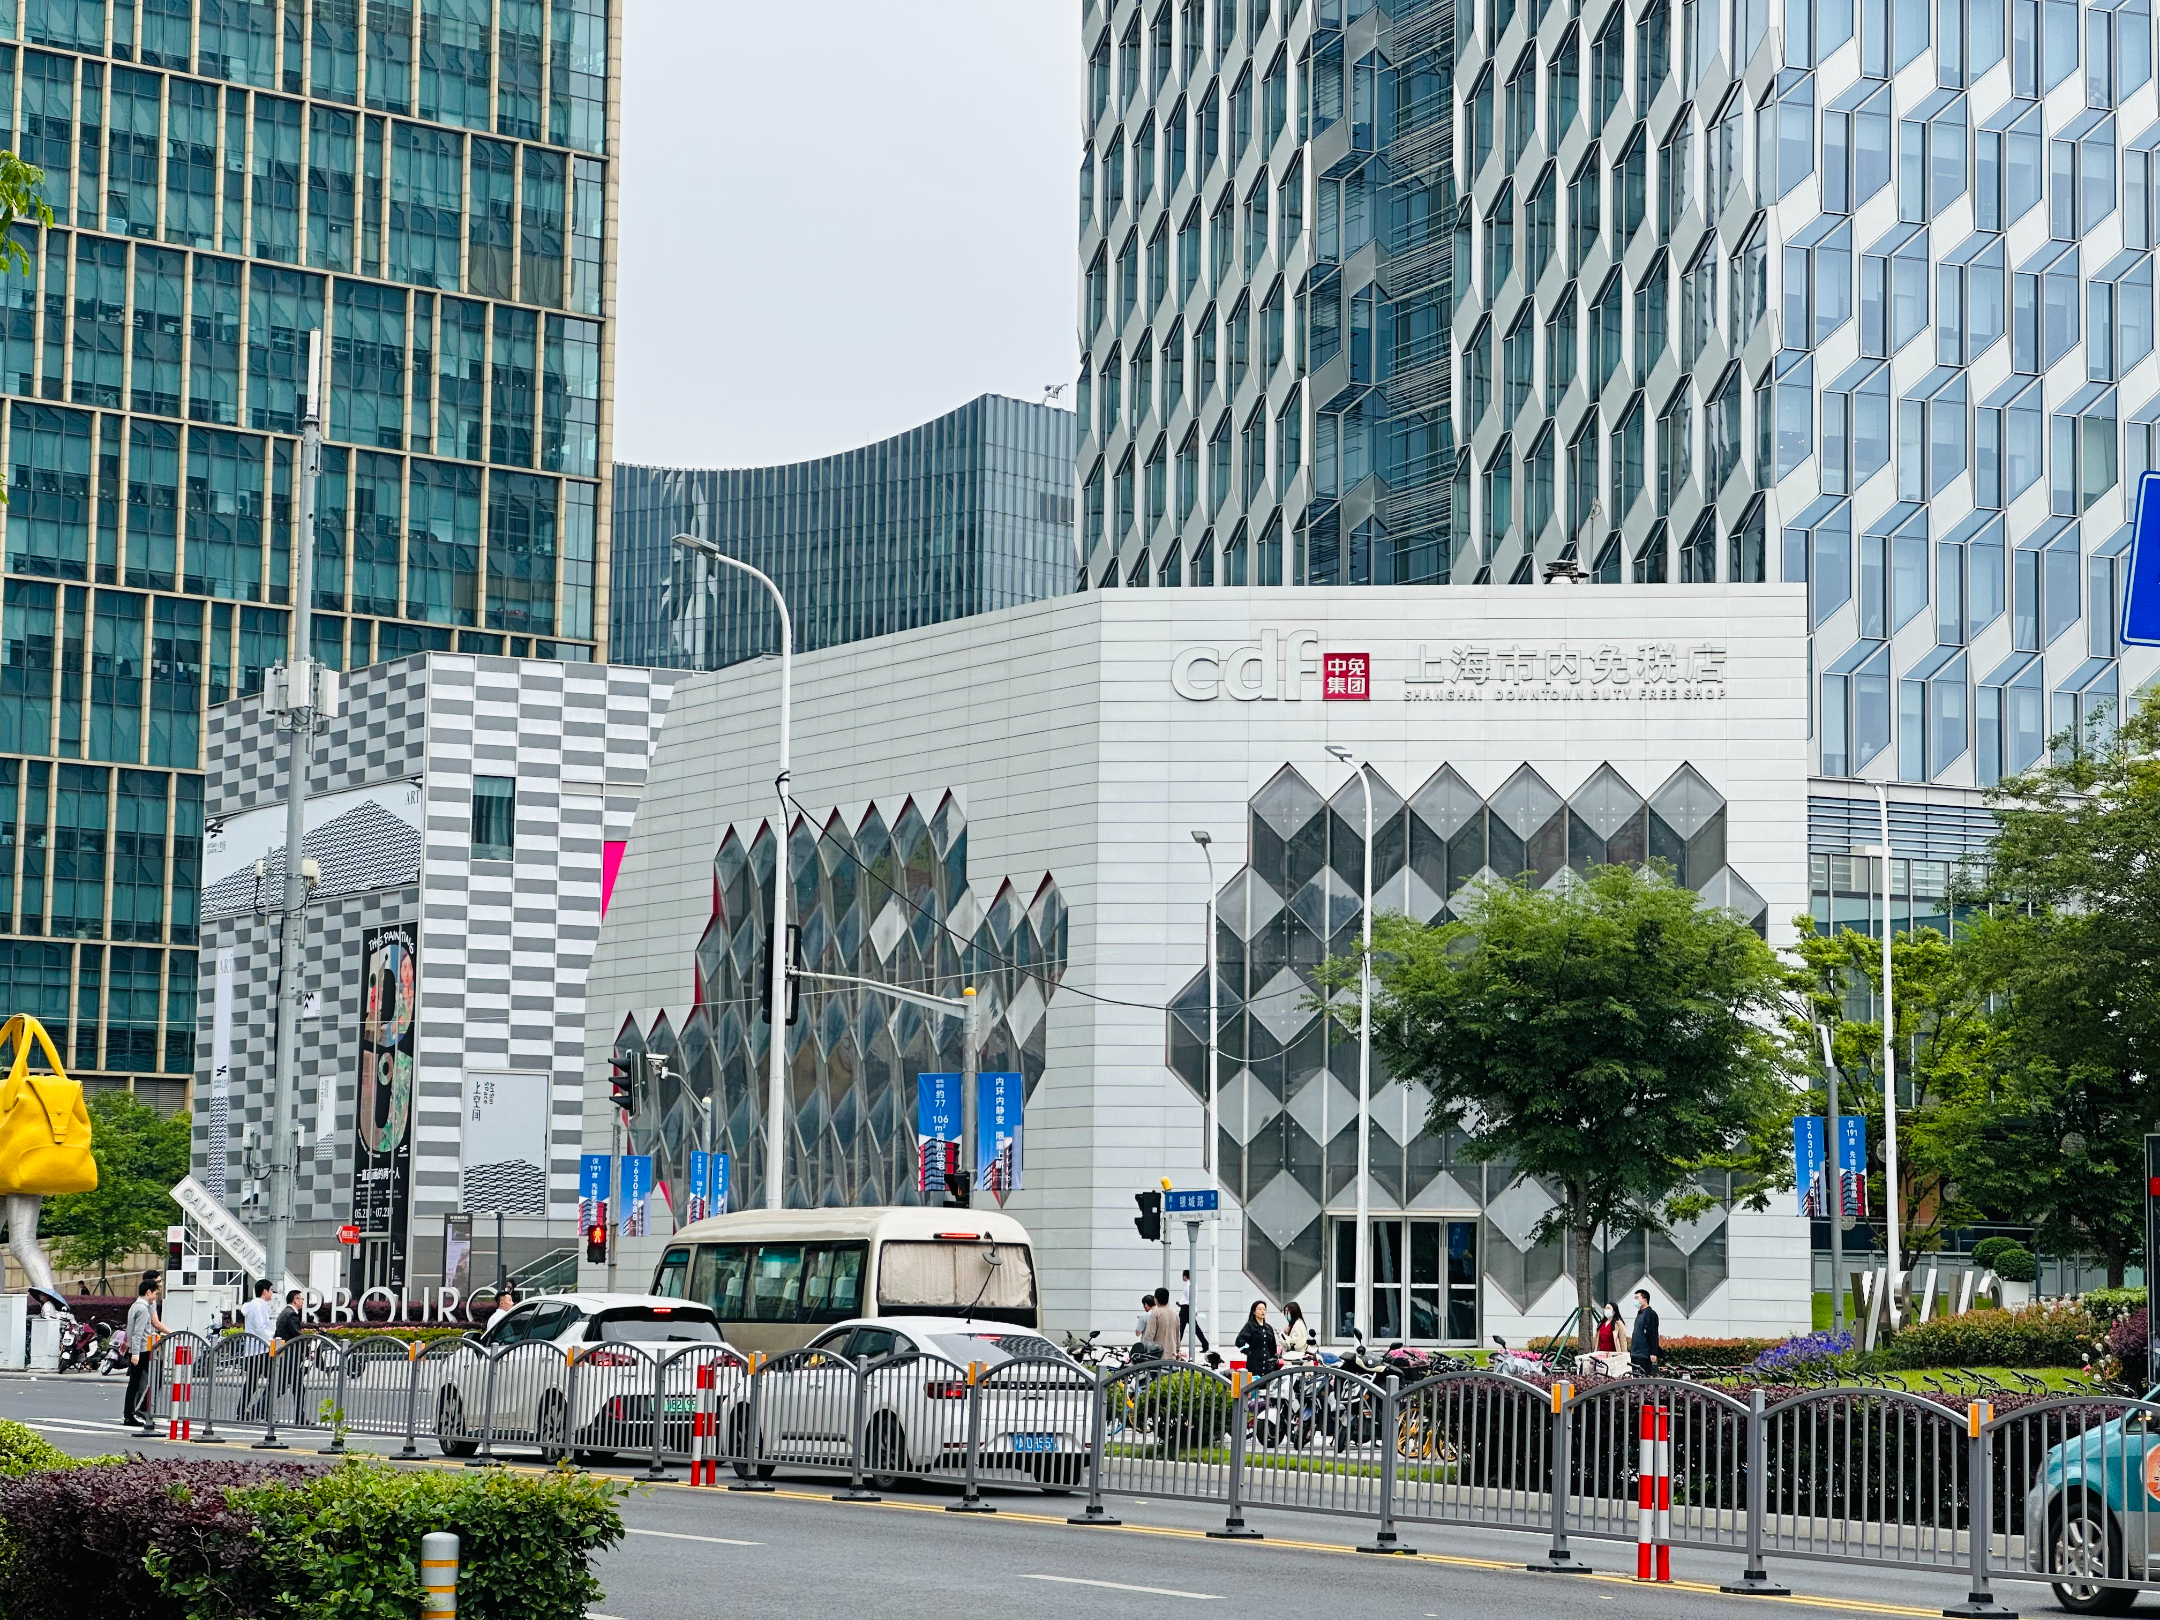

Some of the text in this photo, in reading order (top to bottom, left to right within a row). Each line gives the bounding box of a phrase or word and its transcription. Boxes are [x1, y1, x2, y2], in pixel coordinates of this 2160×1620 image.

[1171, 628, 1319, 701] cdf
[1327, 657, 1366, 676] 中免
[1405, 643, 1727, 686] 上海市内免税店
[1327, 676, 1366, 694] 集团
[1404, 688, 1727, 702] SHANGHAI DOWNTOWN DUTY FREE SHOP
[995, 1077, 1005, 1125] 内环内静安
[1806, 1120, 1815, 1197] 56308888
[1180, 1195, 1204, 1208] 银城路
[181, 1186, 267, 1275] GALA AVENUE
[231, 1286, 464, 1323] HRBOUR
